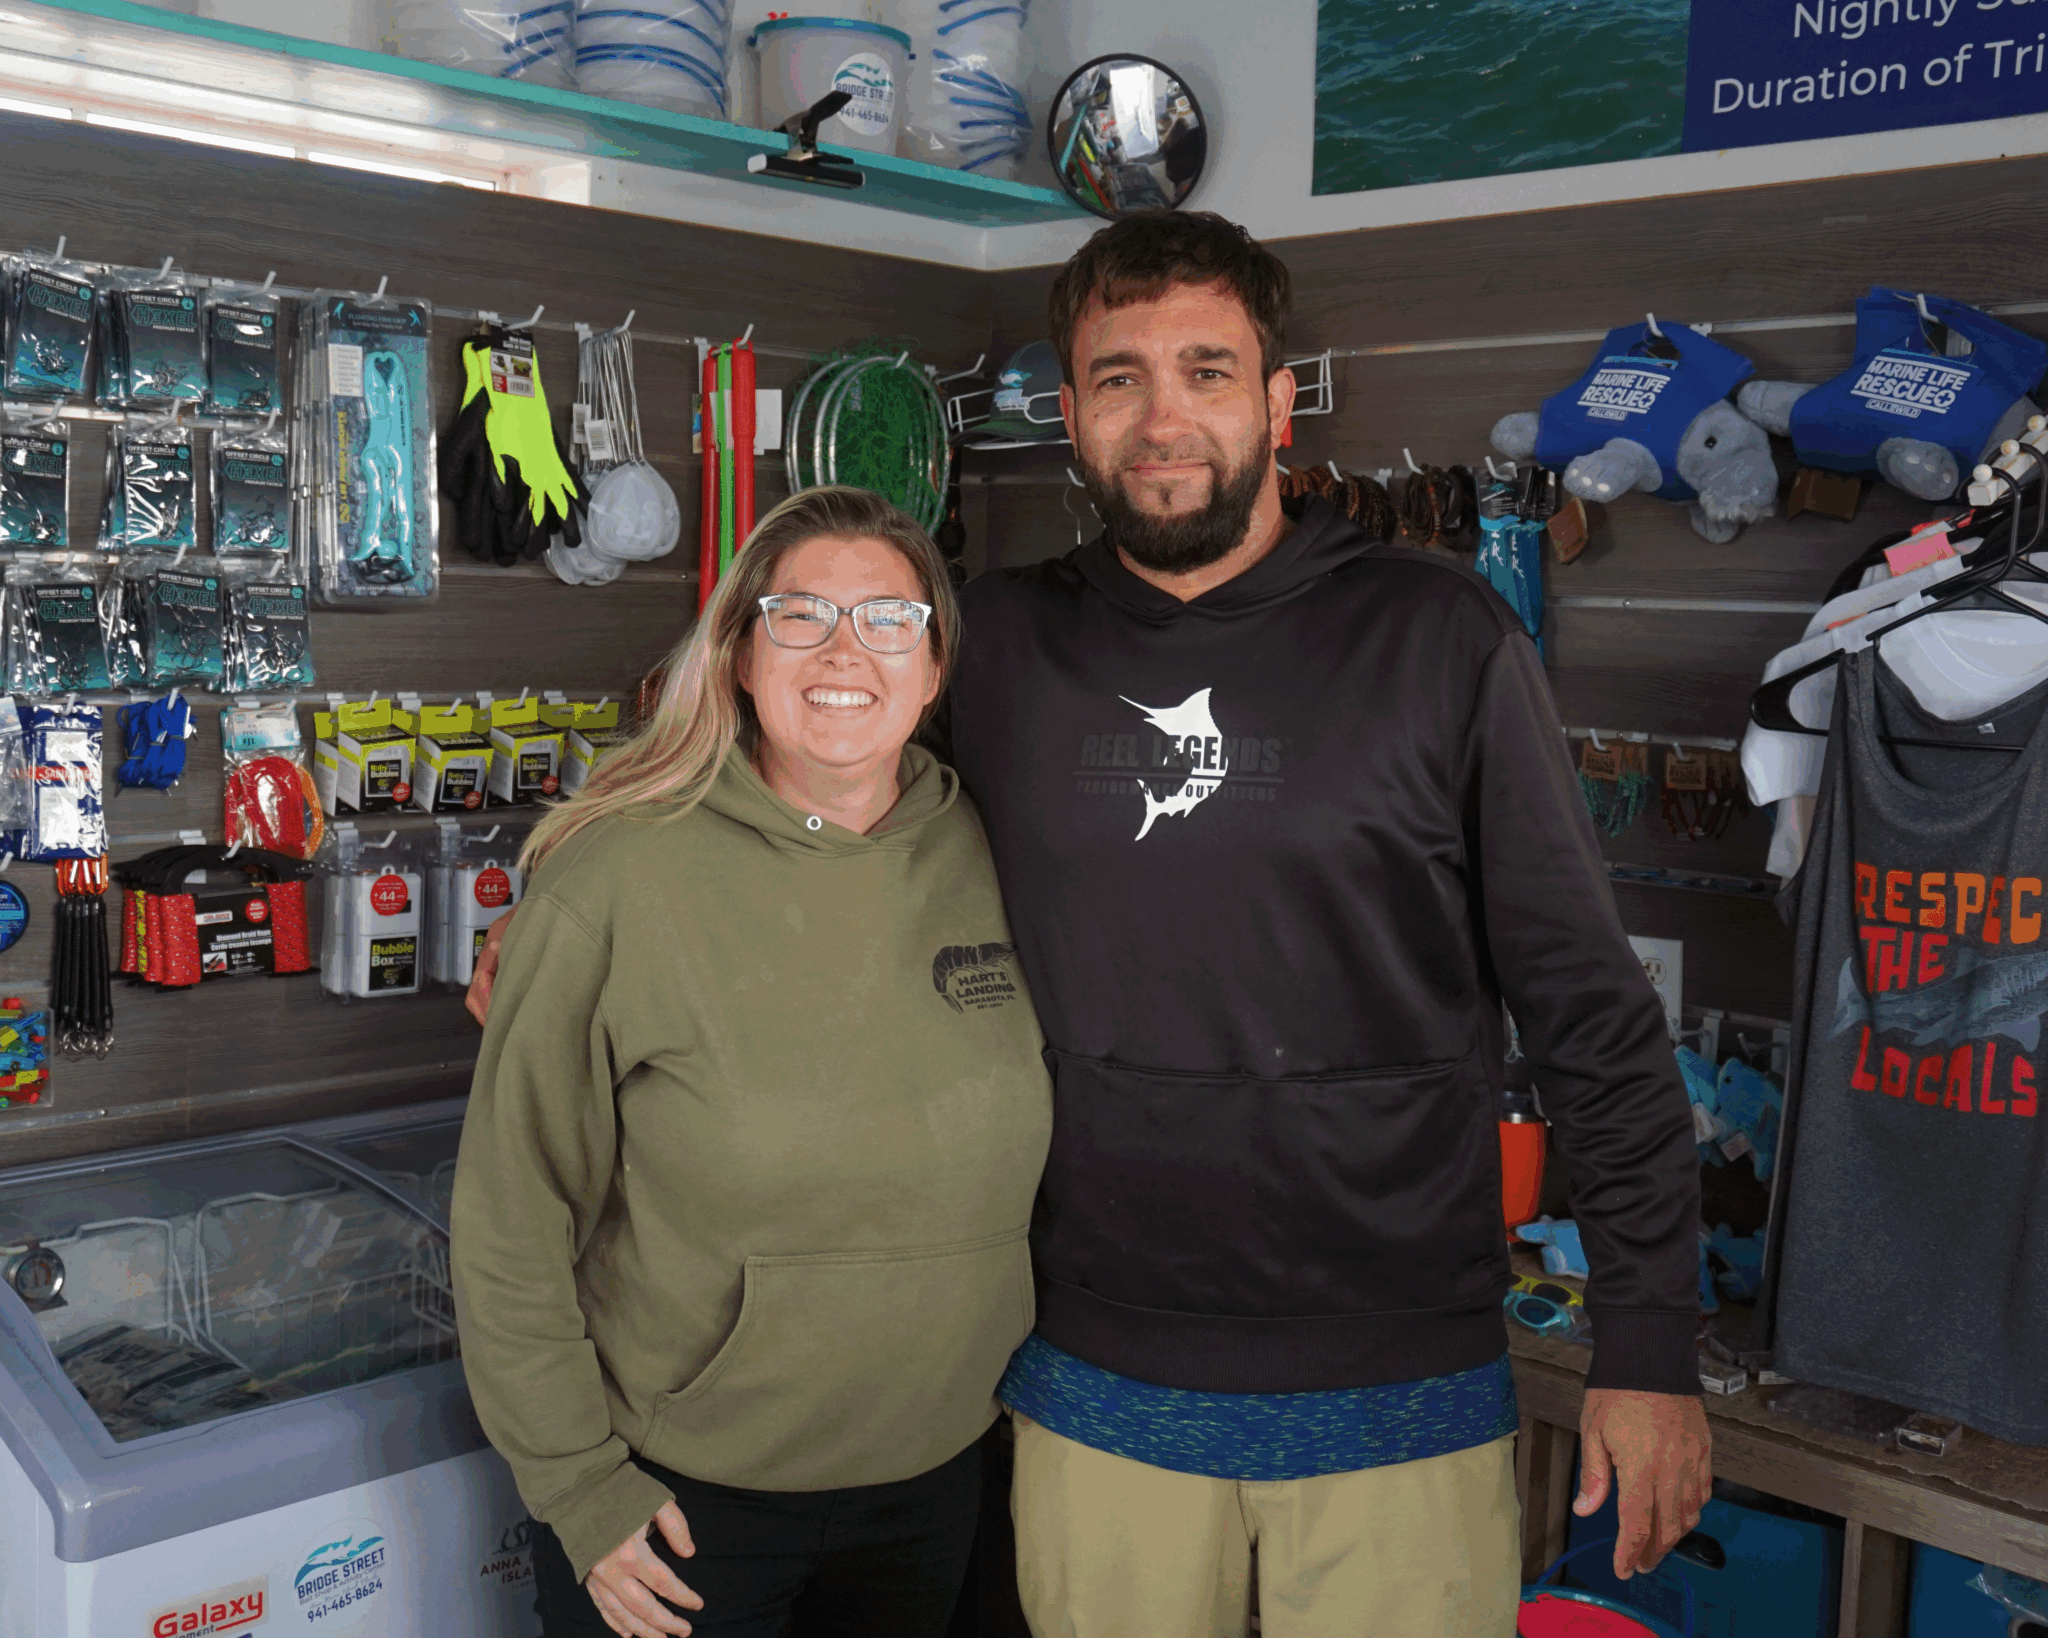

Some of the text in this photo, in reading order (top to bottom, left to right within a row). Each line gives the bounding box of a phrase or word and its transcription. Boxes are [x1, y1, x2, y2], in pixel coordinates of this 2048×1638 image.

[1793, 0, 1954, 40] Nightly
[1712, 59, 1908, 115] Duration
[1923, 42, 1974, 87] of
[836, 82, 868, 98] BRIDGE
[869, 87, 894, 103] STRET
[30, 272, 57, 286] OFFSET
[56, 280, 79, 292] CIRCLE
[30, 284, 92, 320] HEXEL
[131, 294, 156, 303] OFFSET
[134, 304, 197, 328] HEXEL
[217, 308, 261, 321] OFFSET CIRCLE
[1591, 373, 1668, 393] MARINE LIFE
[1865, 360, 1968, 391] MARINE LIFE
[1579, 385, 1644, 407] RESCUE
[1854, 373, 1940, 405] RESCUE
[4, 439, 51, 449] OFFSET CIRCLE
[127, 445, 176, 454] OFFSET CIRCLE
[225, 451, 248, 459] OFFSET
[228, 460, 287, 483] HEXEL
[158, 573, 204, 585] OFFSET CIRCLE
[37, 589, 60, 597] OFFSET
[160, 583, 220, 608] HEXEL
[269, 587, 290, 595] CIRCLE
[42, 600, 97, 622] HEXEL
[250, 596, 307, 617] HEXEL
[1080, 733, 1283, 774] REEL LEGENDS
[370, 770, 399, 779] Bubbles
[522, 763, 548, 771] Bubbles
[446, 777, 474, 786] Bubbles
[1076, 779, 1278, 802] PERFORMANCE OUTFITTERS
[379, 890, 396, 902] 44
[1854, 861, 2043, 945] RESPEC
[210, 942, 229, 952] Corde
[249, 938, 273, 947] losange
[215, 929, 272, 942] Diamond Braid Rope
[371, 942, 415, 956] Bubble
[1859, 925, 1949, 994] THE
[371, 955, 395, 968] Box
[957, 971, 1007, 987] HART'S
[955, 983, 1017, 999] LANDING
[1851, 1025, 2039, 1118] LOCALS
[297, 1568, 339, 1600] BRIDGE
[342, 1546, 385, 1579] STREET
[479, 1555, 521, 1577] ANNA
[314, 1586, 333, 1598] Shop
[339, 1573, 363, 1588] Activity
[363, 1561, 386, 1575] Center
[307, 1577, 383, 1624] 941-465-8624
[153, 1590, 263, 1638] Galaxy
